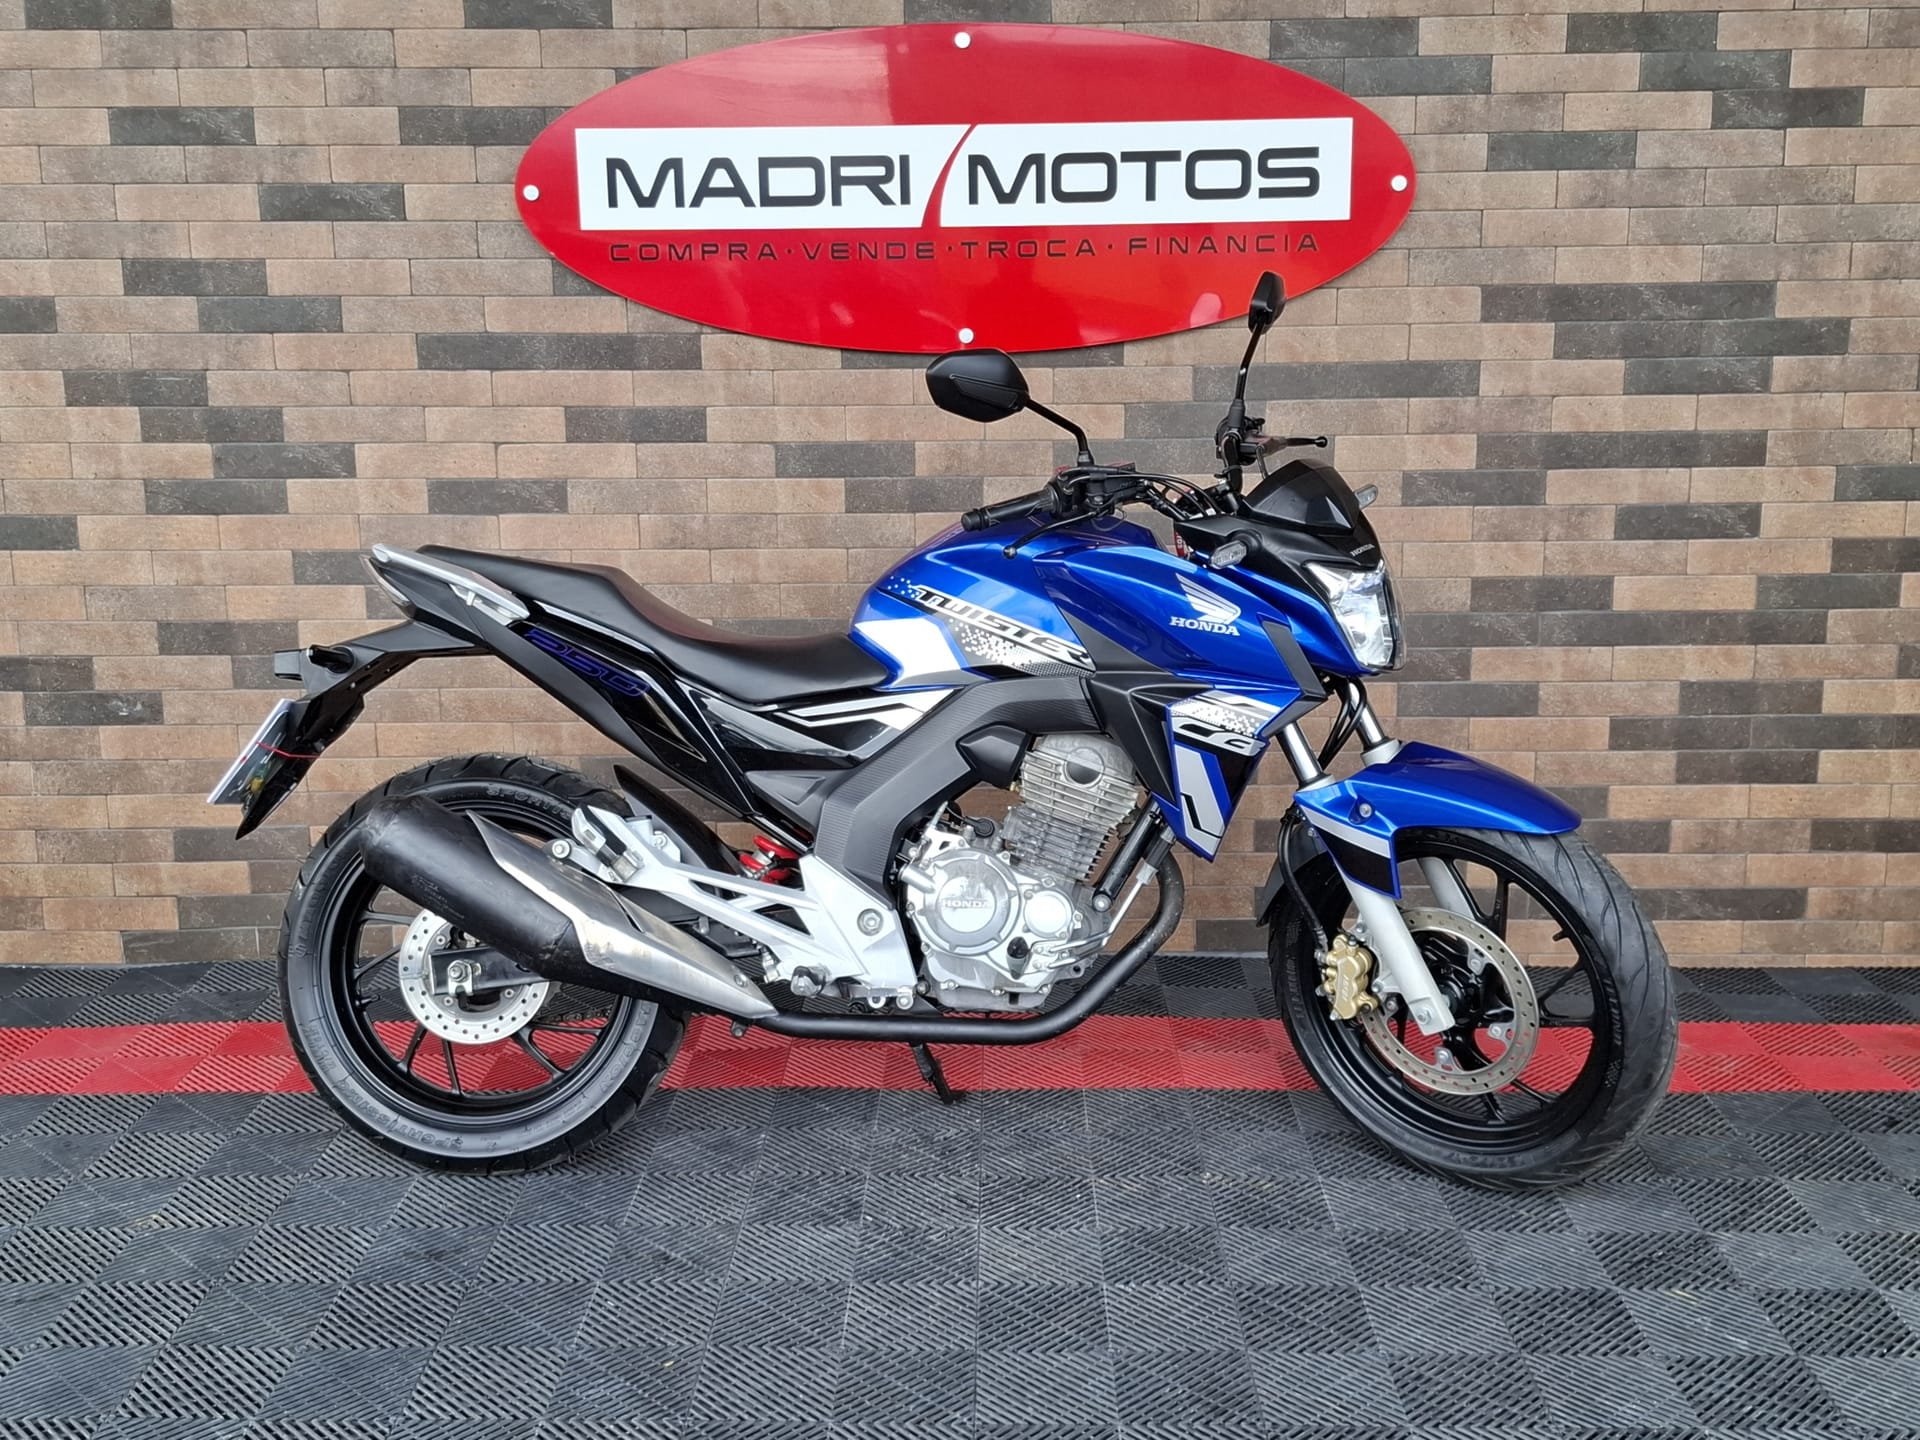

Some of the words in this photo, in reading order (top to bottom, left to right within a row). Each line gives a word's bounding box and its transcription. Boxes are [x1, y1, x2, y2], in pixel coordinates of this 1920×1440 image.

[605, 153, 911, 209] MADRI
[967, 146, 1321, 205] MOTOS
[609, 242, 779, 262] COMPRA
[802, 241, 936, 260] VENDE
[960, 238, 1097, 260] TROCA
[1127, 233, 1320, 256] FINANCIA
[1169, 615, 1241, 637] HONDA
[942, 899, 990, 909] HONDA
